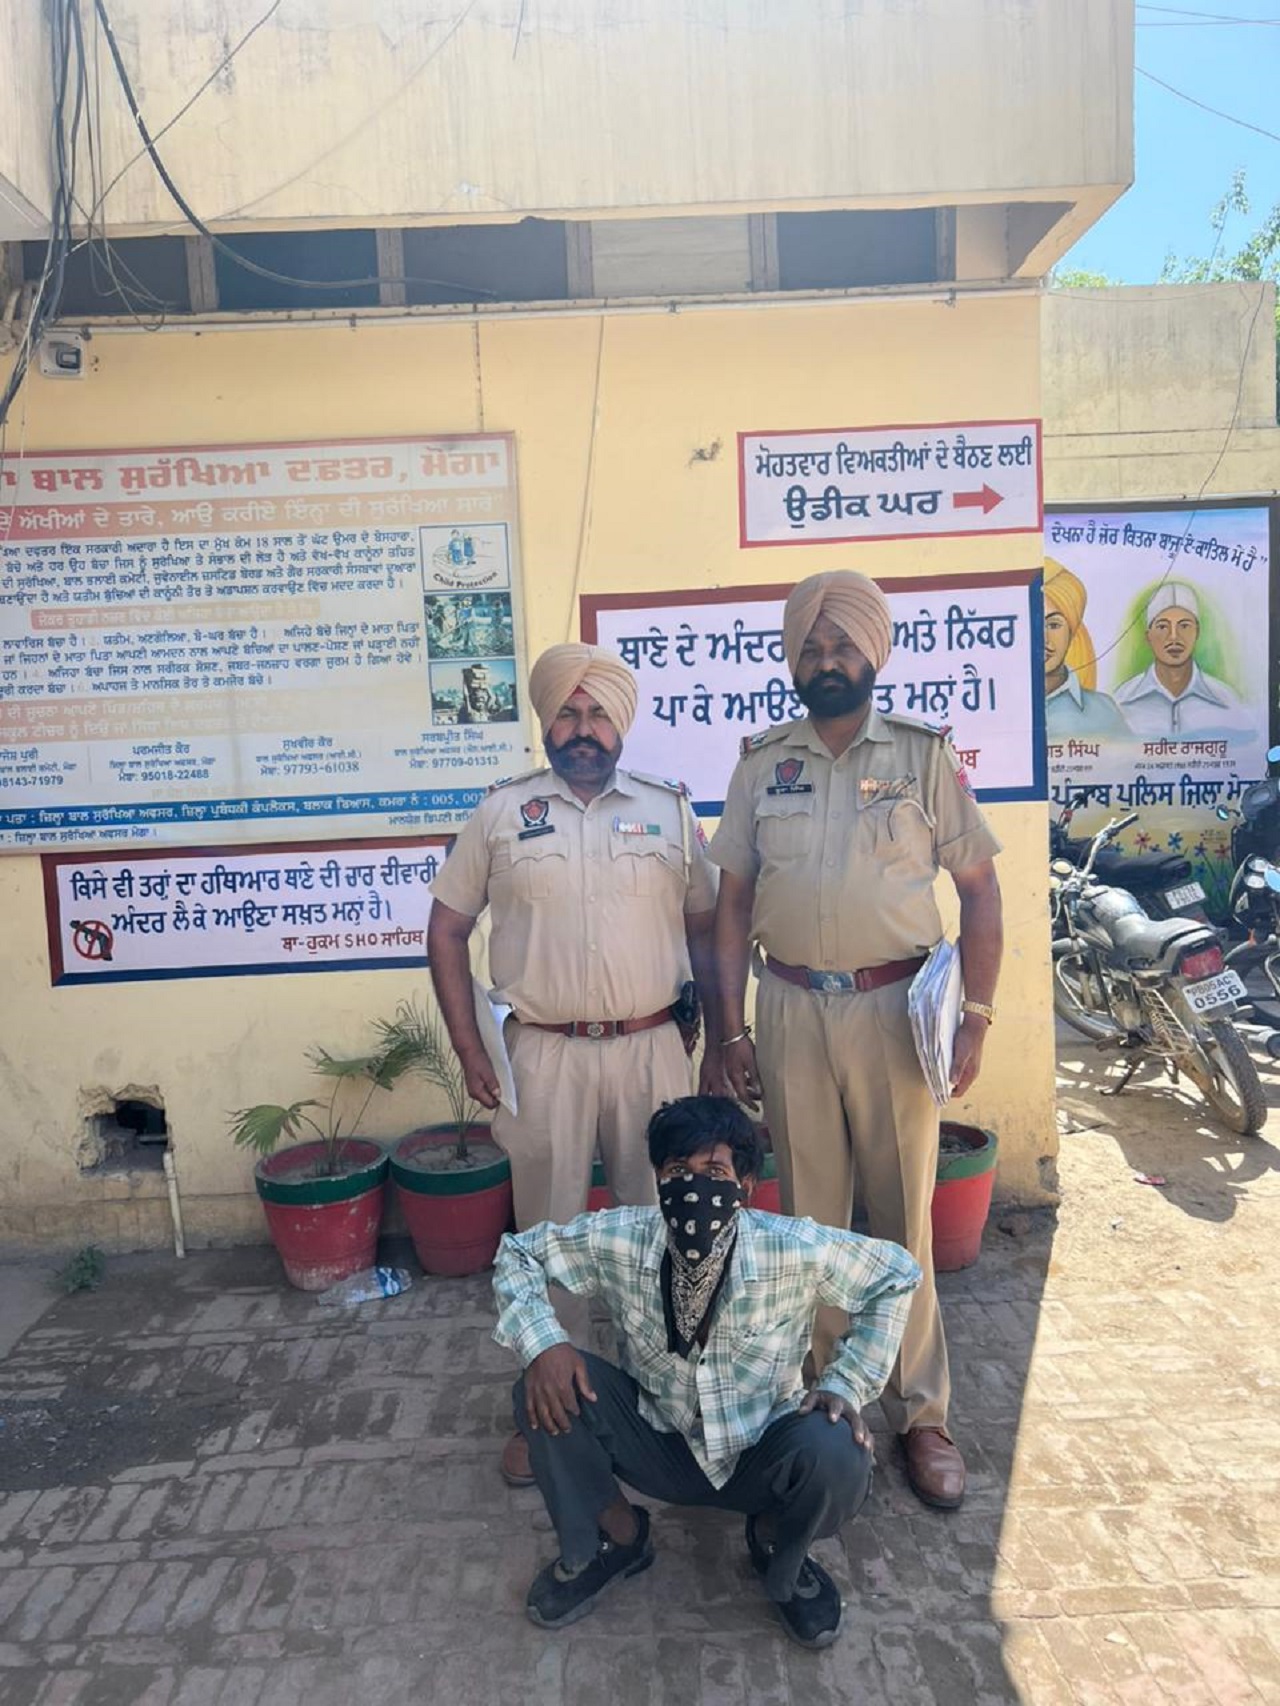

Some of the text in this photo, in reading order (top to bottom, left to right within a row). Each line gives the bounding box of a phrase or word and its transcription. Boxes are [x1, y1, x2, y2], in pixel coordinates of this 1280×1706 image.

[755, 444, 832, 477] ਮੋਹਤਵਾਰ
[935, 440, 949, 470] ਦੇ
[953, 435, 993, 469] ਬੈਠਣ
[998, 435, 1033, 467] ਲਈ
[31, 468, 104, 492] ਬਾਲ
[118, 458, 270, 495] ਸੁਰੱਖਿਆ
[420, 446, 500, 477] ਮੋਗਾ
[92, 506, 110, 527] ਦੇ
[783, 484, 942, 528] ਉਡੀਕ ਘਰ
[85, 540, 122, 553] ਸਰਕਾਰੀ
[161, 538, 169, 551] ਹੈ
[175, 537, 194, 550] ਇਸ
[199, 540, 209, 549] ਦਾ
[257, 537, 269, 548] 18
[273, 536, 292, 546] ਸਾਲ
[332, 531, 356, 546] ਉਮਰ
[361, 530, 369, 543] ਦੇ
[1086, 519, 1096, 543] ਹੈ
[1122, 522, 1156, 548] ਕਿਤਨਾ
[1242, 545, 1258, 572] ਹੈ
[27, 559, 43, 572] ਅਤੇ
[48, 561, 64, 571] ਹਰ
[69, 557, 85, 573] ਉਹ
[114, 556, 134, 569] ਜਿਸ
[240, 551, 251, 564] ਦੀ
[277, 548, 285, 562] ਹੈ
[290, 548, 307, 561] ਅਤੇ
[388, 545, 415, 557] ਤਹਿਤ
[64, 576, 82, 586] ਬਾਲ
[267, 565, 283, 578] ਅਤੇ
[307, 562, 343, 576] ਸਰਕਾਰੀ
[41, 589, 49, 602] ਹੈ
[53, 589, 69, 602] ਅਤੇ
[139, 585, 150, 598] ਦੀ
[357, 580, 383, 590] ਕਰਦਾ
[387, 575, 395, 589] ਹੈ
[69, 633, 77, 646] ਹੈ
[249, 626, 257, 639] ਹੈ
[361, 621, 369, 634] ਦੇ
[373, 623, 393, 634] ਮਾਤਾ
[397, 620, 420, 633] ਪਿਤਾ
[617, 604, 1018, 669] ਥਾਣੇ ਦੇ ਅੰਦਰ ਅਤੇ ਨਿੱਕਰ
[52, 650, 61, 663] ਦੇ
[64, 652, 86, 662] ਮਾਤਾ
[91, 648, 112, 661] ਪਿਤਾ
[189, 647, 208, 657] ਨਾਲ
[278, 644, 289, 653] ਦਾ
[108, 663, 128, 676] ਜਿਸ
[132, 664, 152, 674] ਨਾਲ
[653, 696, 688, 727] ਪਾ
[692, 684, 713, 725] ਕੇ
[1068, 739, 1101, 758] ਸਿੰਘ
[1180, 740, 1228, 759] ਰਾਜਗੁਰੂ
[283, 761, 360, 775] 97793-61038
[432, 755, 498, 769] 97709-01313
[141, 768, 209, 782] 95018-22488
[1117, 775, 1175, 811] ਪੁਲਿਸ
[68, 811, 89, 822] ਬਾਲ
[39, 832, 57, 842] ਬਾਲ
[69, 870, 108, 900] ਕਿਸੇ
[112, 868, 134, 898] ਵੀ
[176, 873, 197, 895] ਦਾ
[201, 864, 280, 894] ਹਥਿਆਰ
[284, 861, 314, 890] ਥਾਣੇ
[319, 859, 341, 888] ਦੀ
[344, 865, 375, 887] ਚਾਰ
[380, 855, 439, 886] ਦੀਵਾਰੀ
[111, 905, 167, 934] ਅੰਦਰ
[212, 899, 277, 933] ਆਉਣਾ
[345, 932, 378, 949] SHO
[382, 926, 424, 947] ਸਾਹਿਬ
[1193, 985, 1241, 1010] 0556
